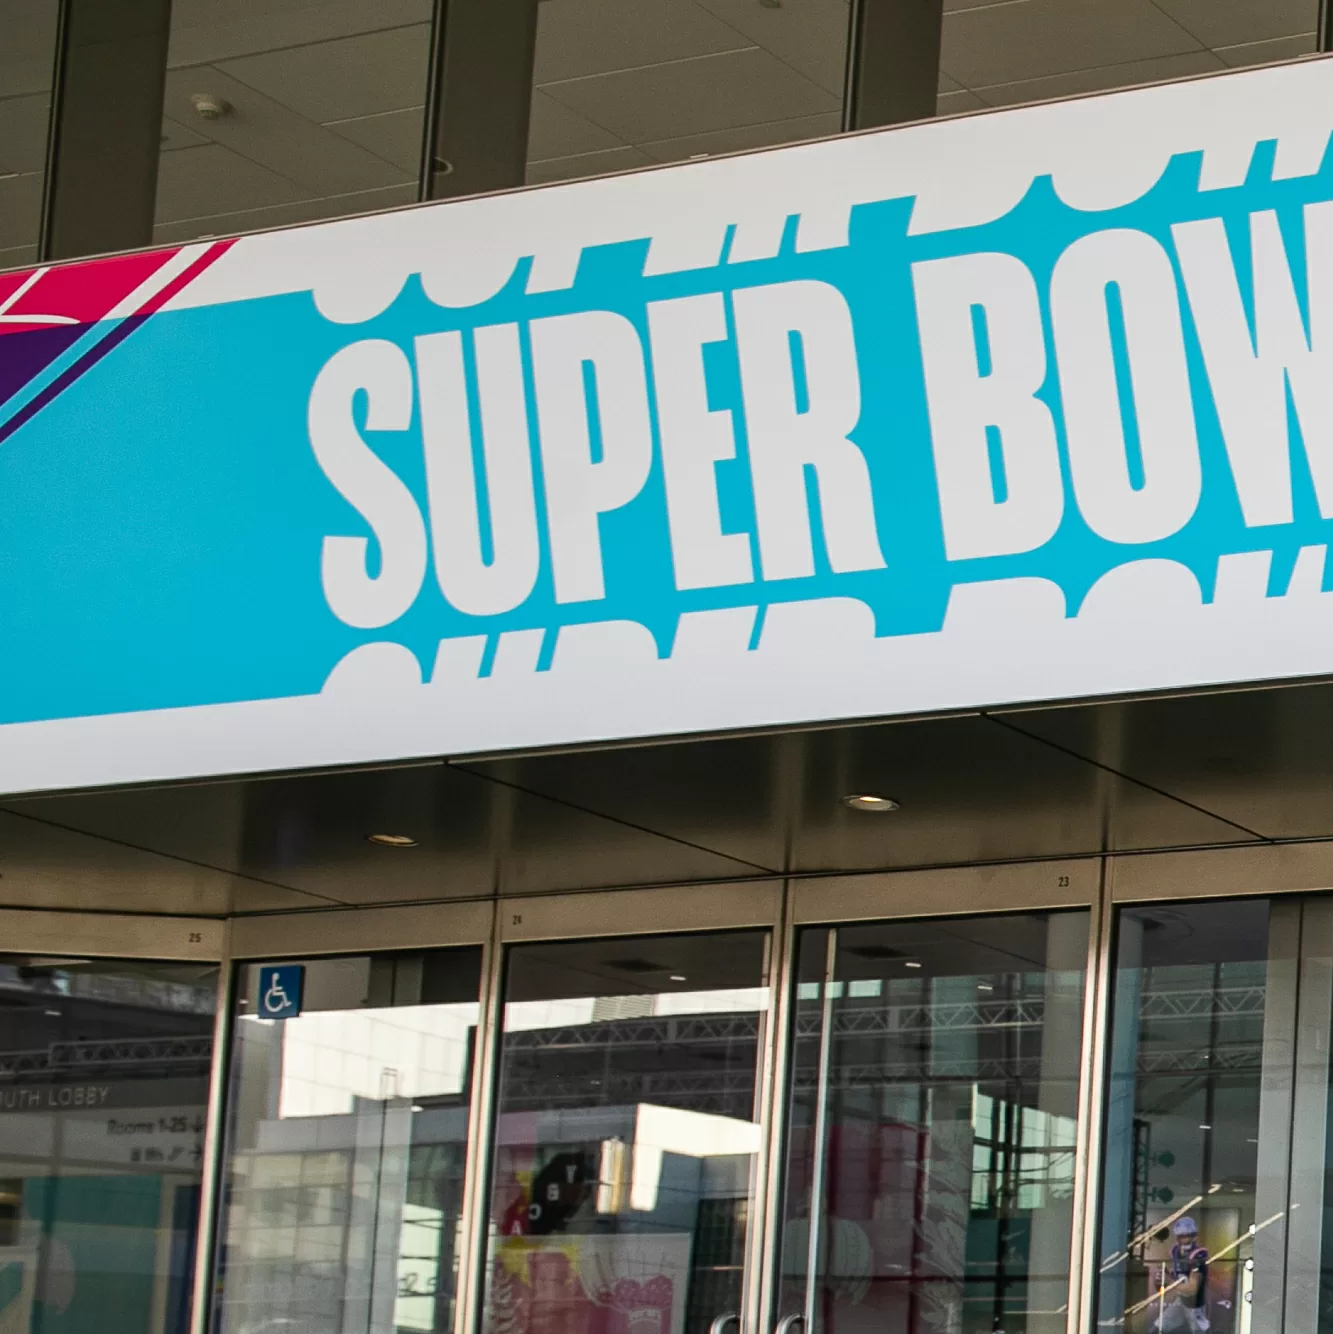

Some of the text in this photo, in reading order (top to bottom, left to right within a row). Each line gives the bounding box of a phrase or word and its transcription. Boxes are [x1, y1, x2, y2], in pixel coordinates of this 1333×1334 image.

[307, 279, 889, 630] SUPER
[1058, 876, 1069, 887] 23
[0, 1089, 40, 1108] UTH
